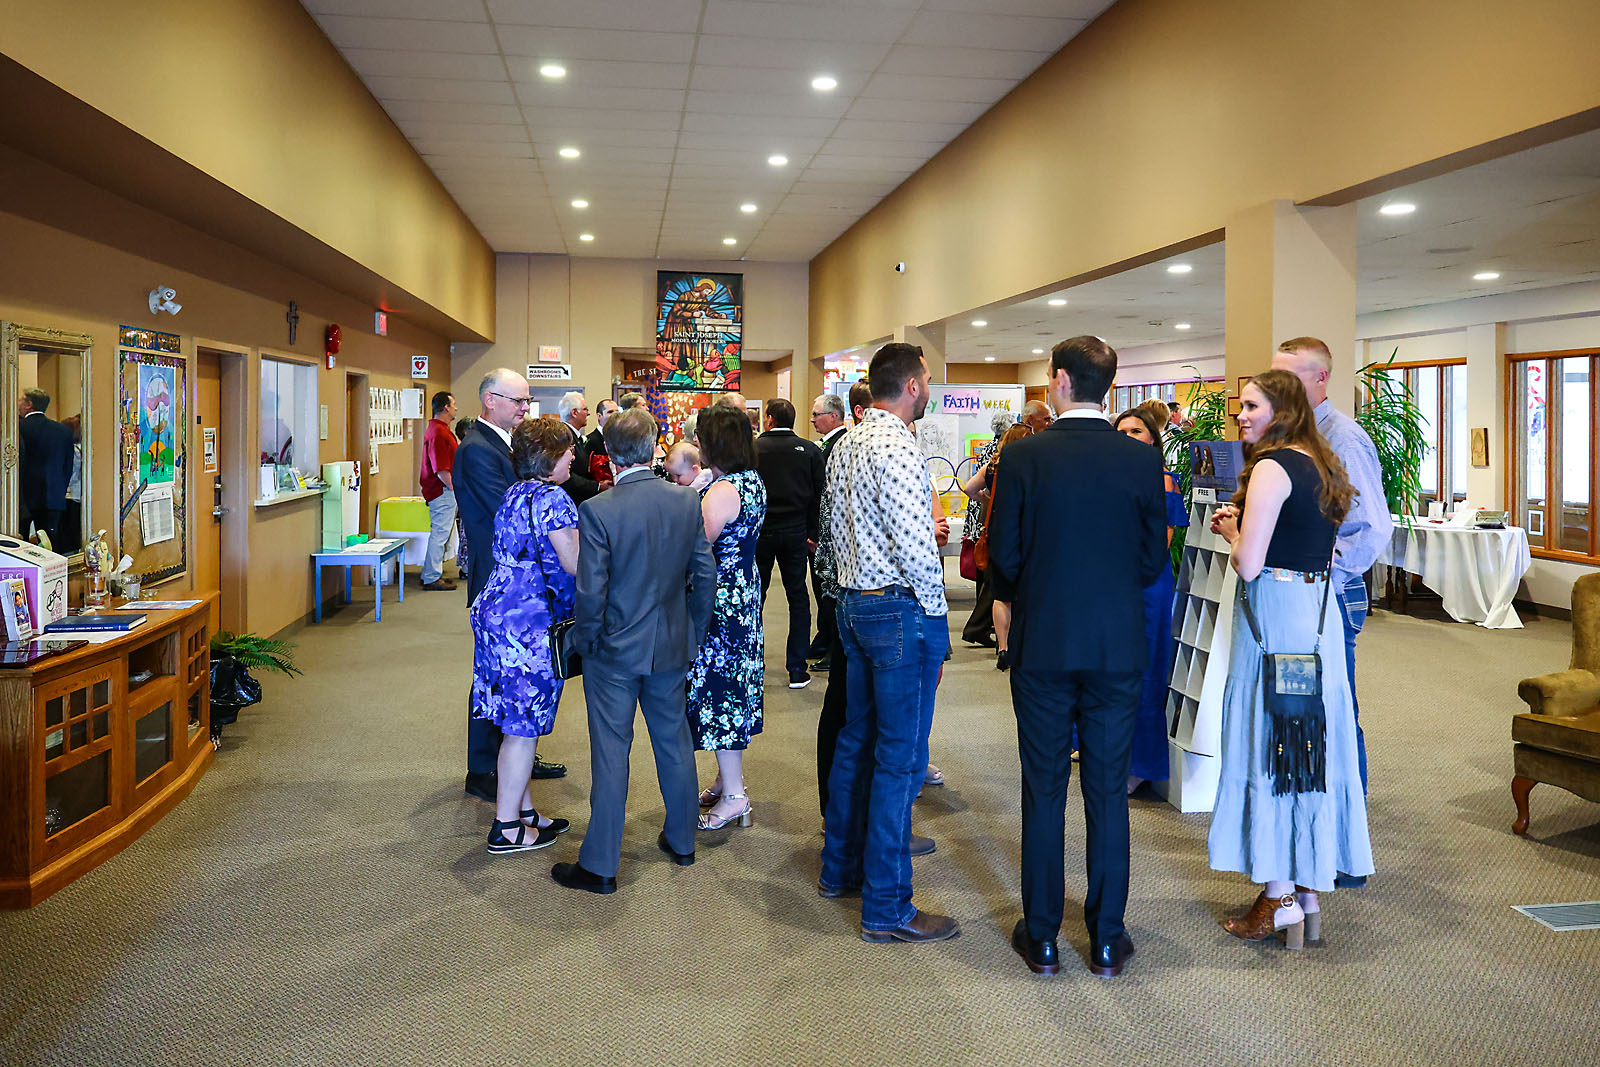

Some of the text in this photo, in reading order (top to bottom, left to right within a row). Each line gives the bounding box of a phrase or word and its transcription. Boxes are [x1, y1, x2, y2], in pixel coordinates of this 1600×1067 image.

[633, 368, 646, 378] THE
[943, 394, 980, 409] FAITH
[983, 399, 1011, 412] WEEK
